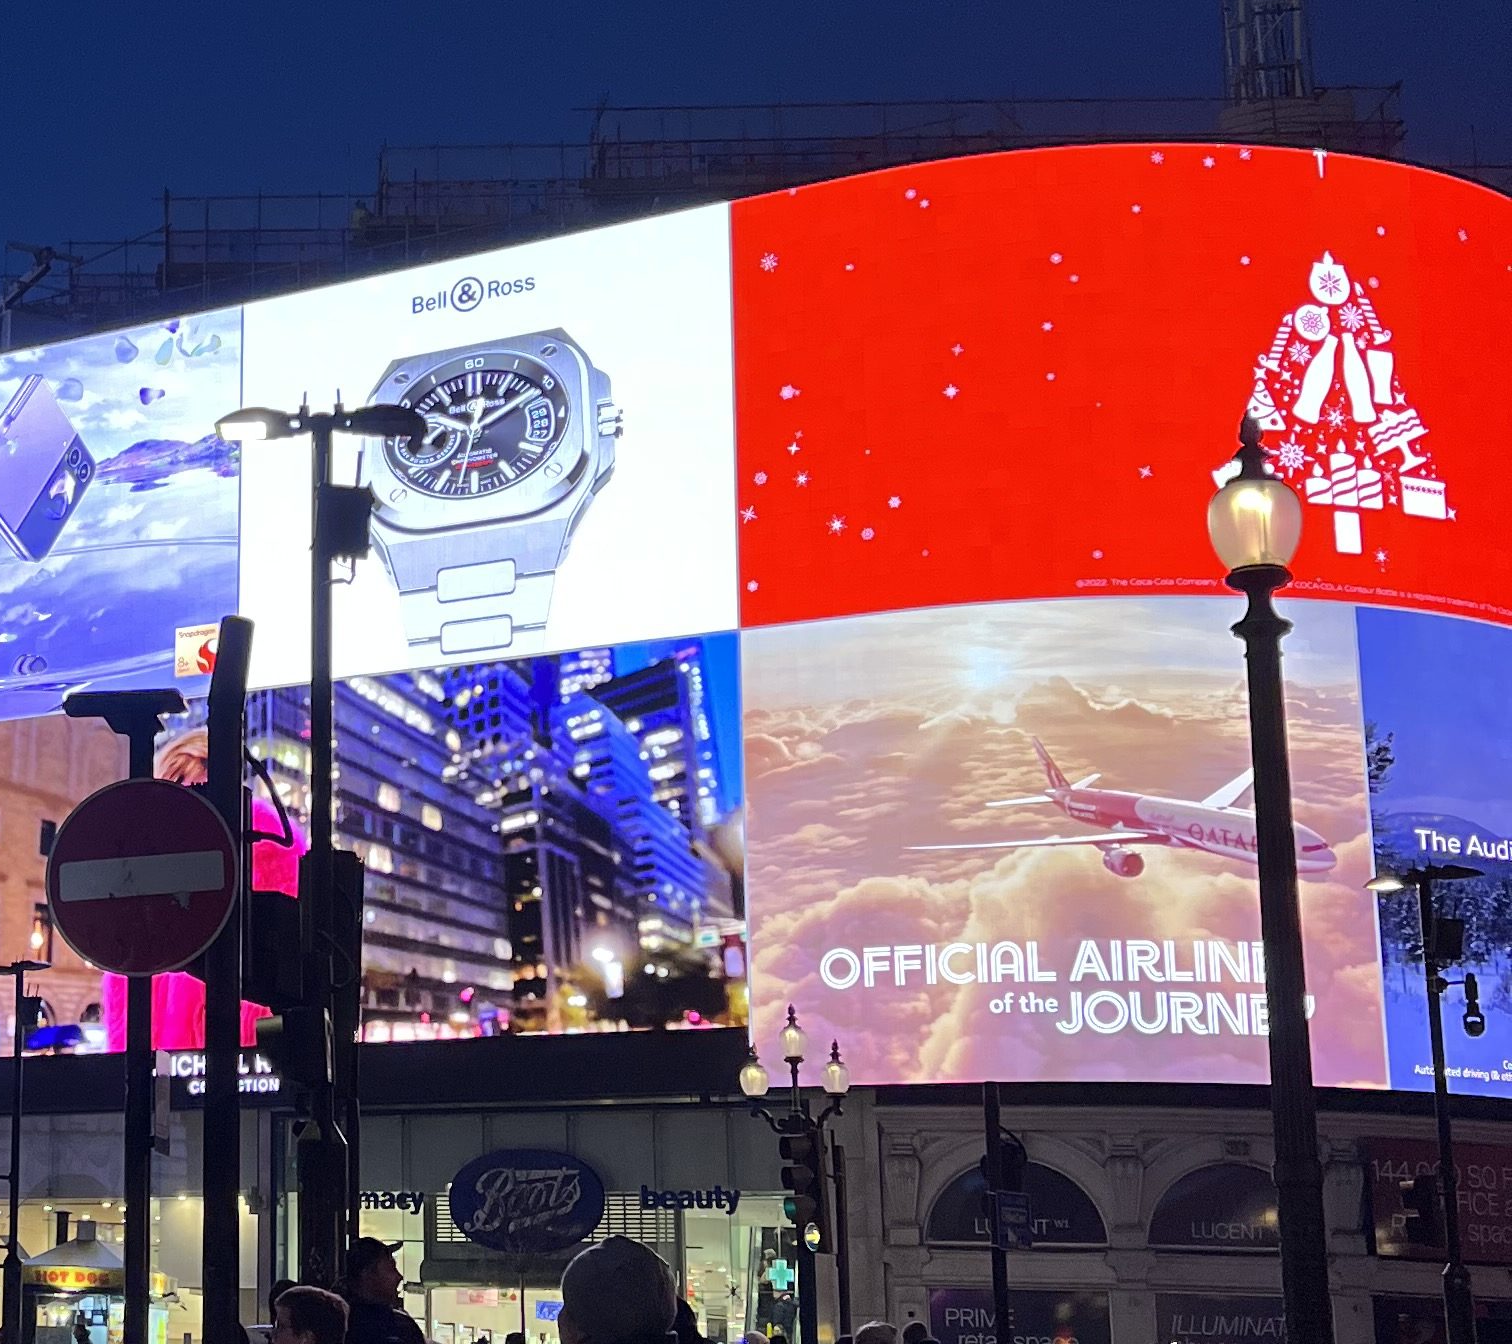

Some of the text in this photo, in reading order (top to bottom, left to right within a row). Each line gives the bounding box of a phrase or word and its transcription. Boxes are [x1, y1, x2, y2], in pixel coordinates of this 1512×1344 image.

[412, 290, 447, 314] Bell
[487, 277, 536, 299] Ross
[464, 358, 484, 369] 60
[541, 374, 554, 389] 10
[1130, 578, 1175, 587] Coca-Cola
[1175, 579, 1218, 588] Company
[1294, 581, 1342, 592] COCA-COLA
[1414, 829, 1462, 854] The
[820, 940, 1057, 990] OFFICIAL
[989, 991, 1315, 1036] of the JOURNE
[152, 1054, 250, 1077] ICHL
[1414, 1064, 1461, 1078] Autoted
[1462, 1067, 1490, 1082] driving
[1467, 1165, 1497, 1190] SQ
[464, 1166, 583, 1233] Boots
[640, 1185, 741, 1214] beauty
[1455, 1191, 1500, 1216] FICE
[974, 1218, 1049, 1235] LUNT
[1191, 1221, 1264, 1240] LUCENT
[35, 1270, 110, 1284] HOT DOG
